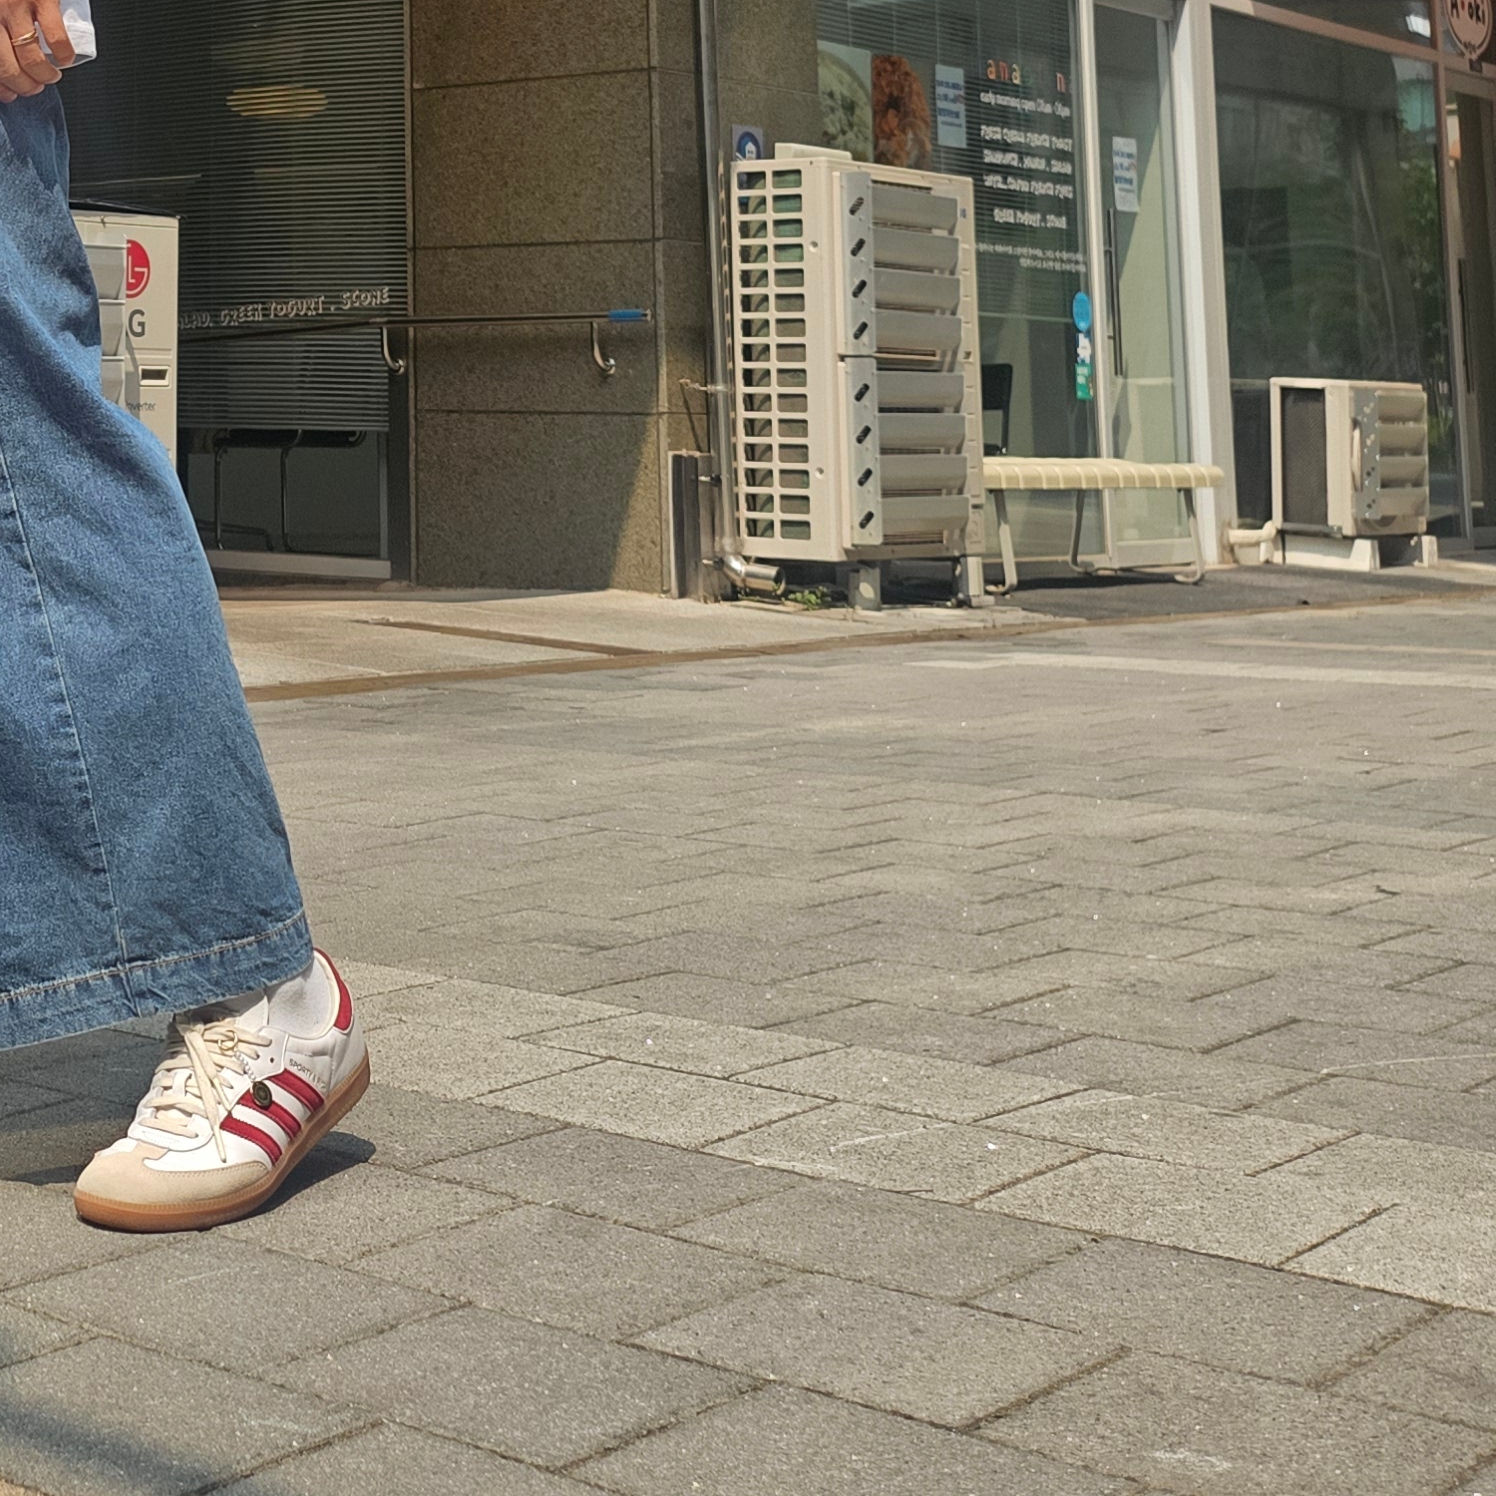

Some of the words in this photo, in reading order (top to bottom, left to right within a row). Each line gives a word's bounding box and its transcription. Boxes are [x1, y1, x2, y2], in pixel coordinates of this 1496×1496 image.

[269, 295, 325, 319] YOGURT
[341, 287, 390, 310] SCONE
[127, 308, 146, 338] G
